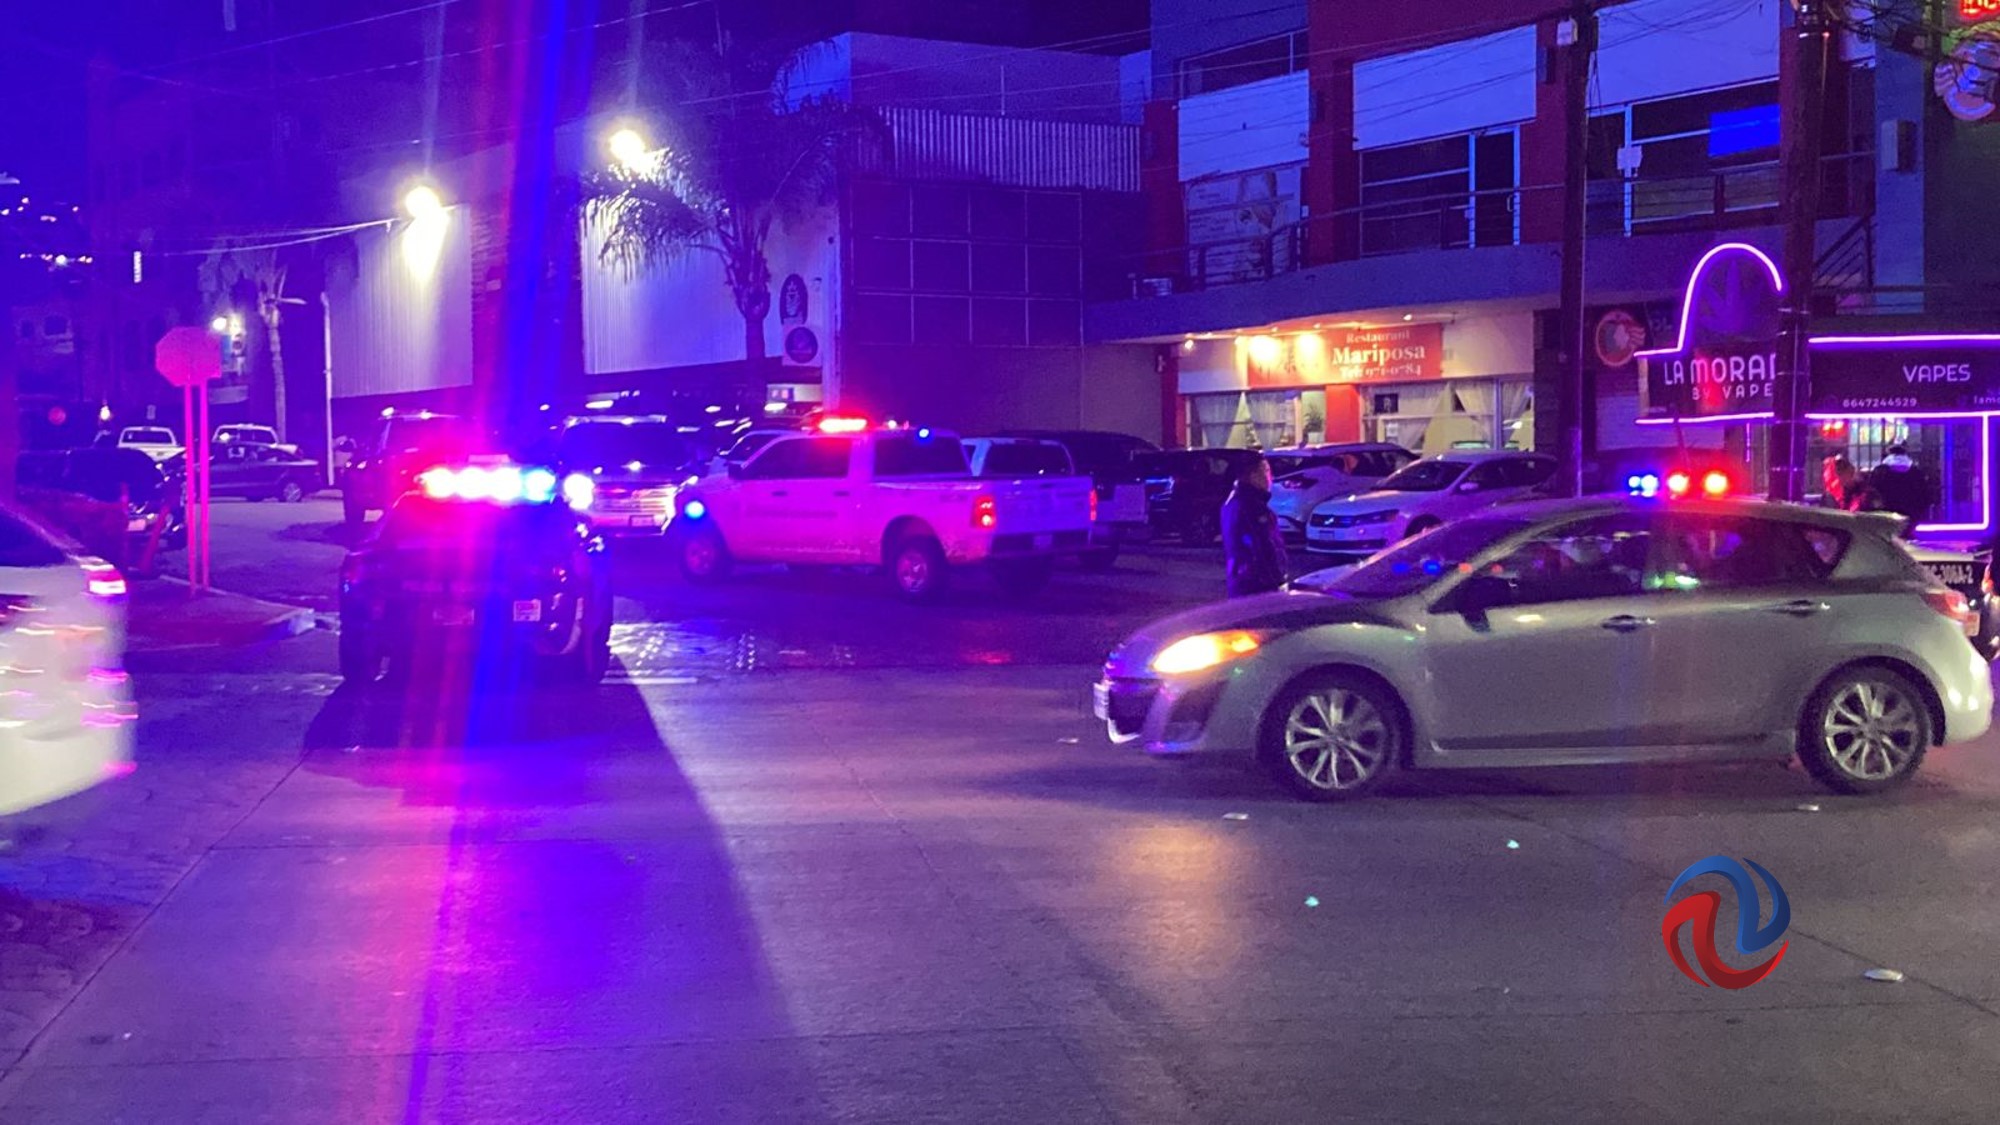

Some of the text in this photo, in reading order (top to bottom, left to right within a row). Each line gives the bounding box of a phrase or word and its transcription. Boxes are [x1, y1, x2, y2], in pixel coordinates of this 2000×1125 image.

[1346, 329, 1410, 344] Restaurant
[1332, 343, 1426, 367] Mariposa
[1365, 364, 1422, 378] 971-0784
[1664, 360, 1684, 385] LA
[1902, 363, 1971, 383] VAPES
[1691, 382, 1773, 401] BY VAPE
